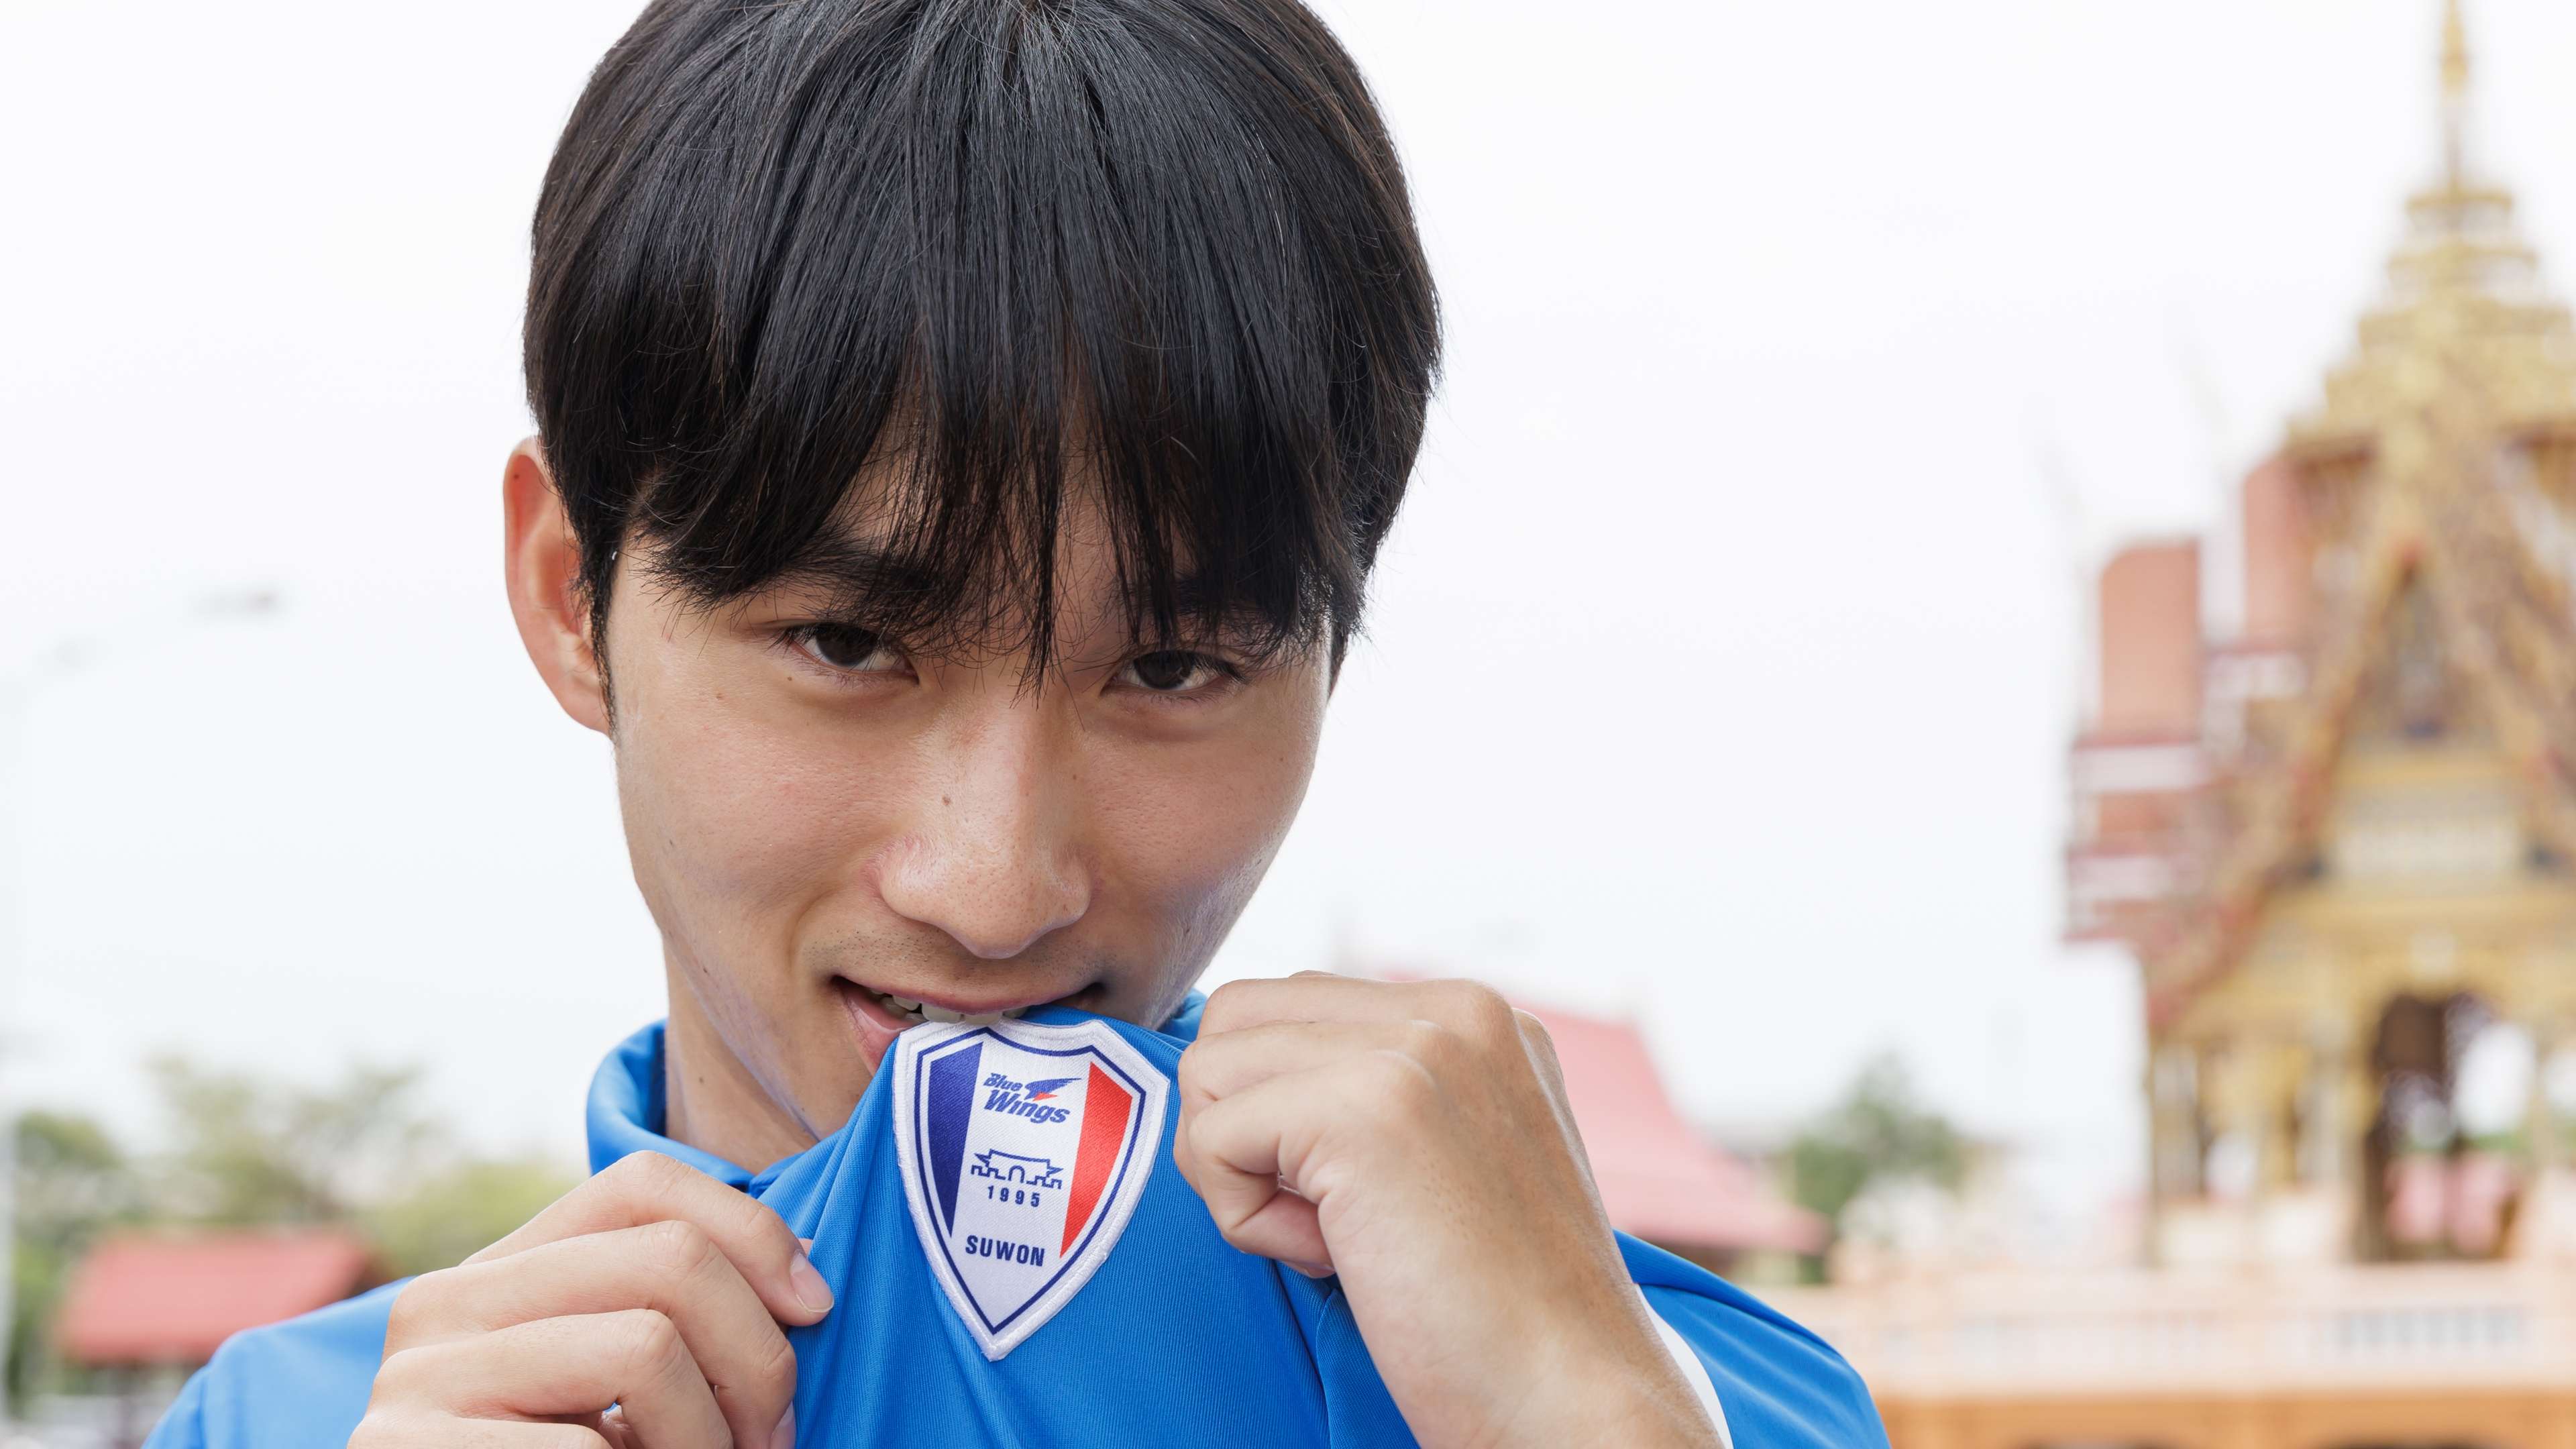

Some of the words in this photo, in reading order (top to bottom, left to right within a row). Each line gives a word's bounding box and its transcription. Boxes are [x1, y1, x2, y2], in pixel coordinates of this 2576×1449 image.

[983, 1073, 1023, 1092] Blue
[983, 1089, 1071, 1124] Wings
[987, 1185, 1040, 1208] 1995
[965, 1235, 1044, 1267] SUWON
